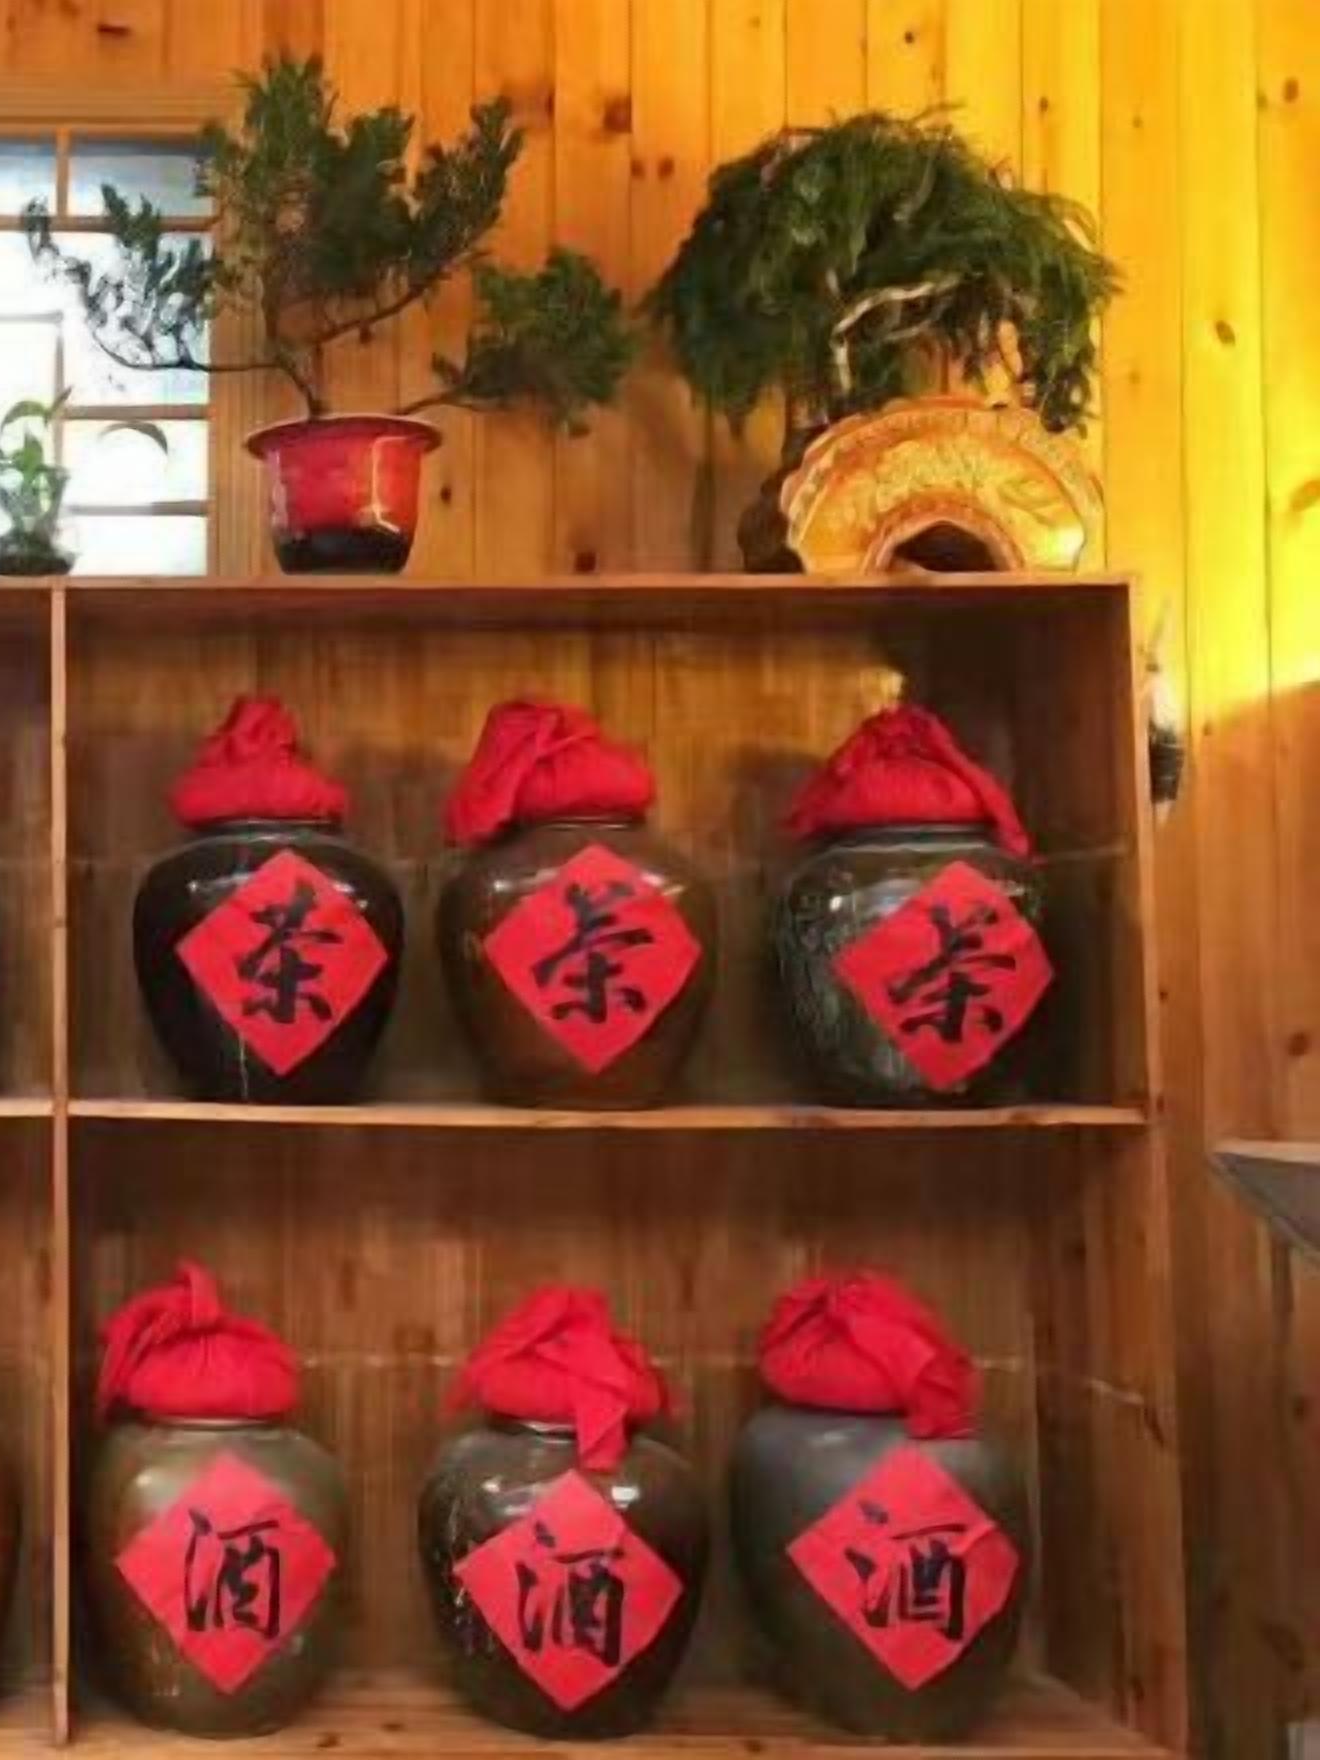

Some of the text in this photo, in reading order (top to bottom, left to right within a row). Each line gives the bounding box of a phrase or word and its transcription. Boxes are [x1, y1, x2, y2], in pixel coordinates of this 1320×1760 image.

[236, 885, 341, 1023] 茶
[530, 882, 652, 1023] 茶
[886, 904, 1016, 1044] 茶
[183, 1510, 281, 1640] 酒
[517, 1522, 626, 1667] 酒
[846, 1502, 968, 1641] 酒
